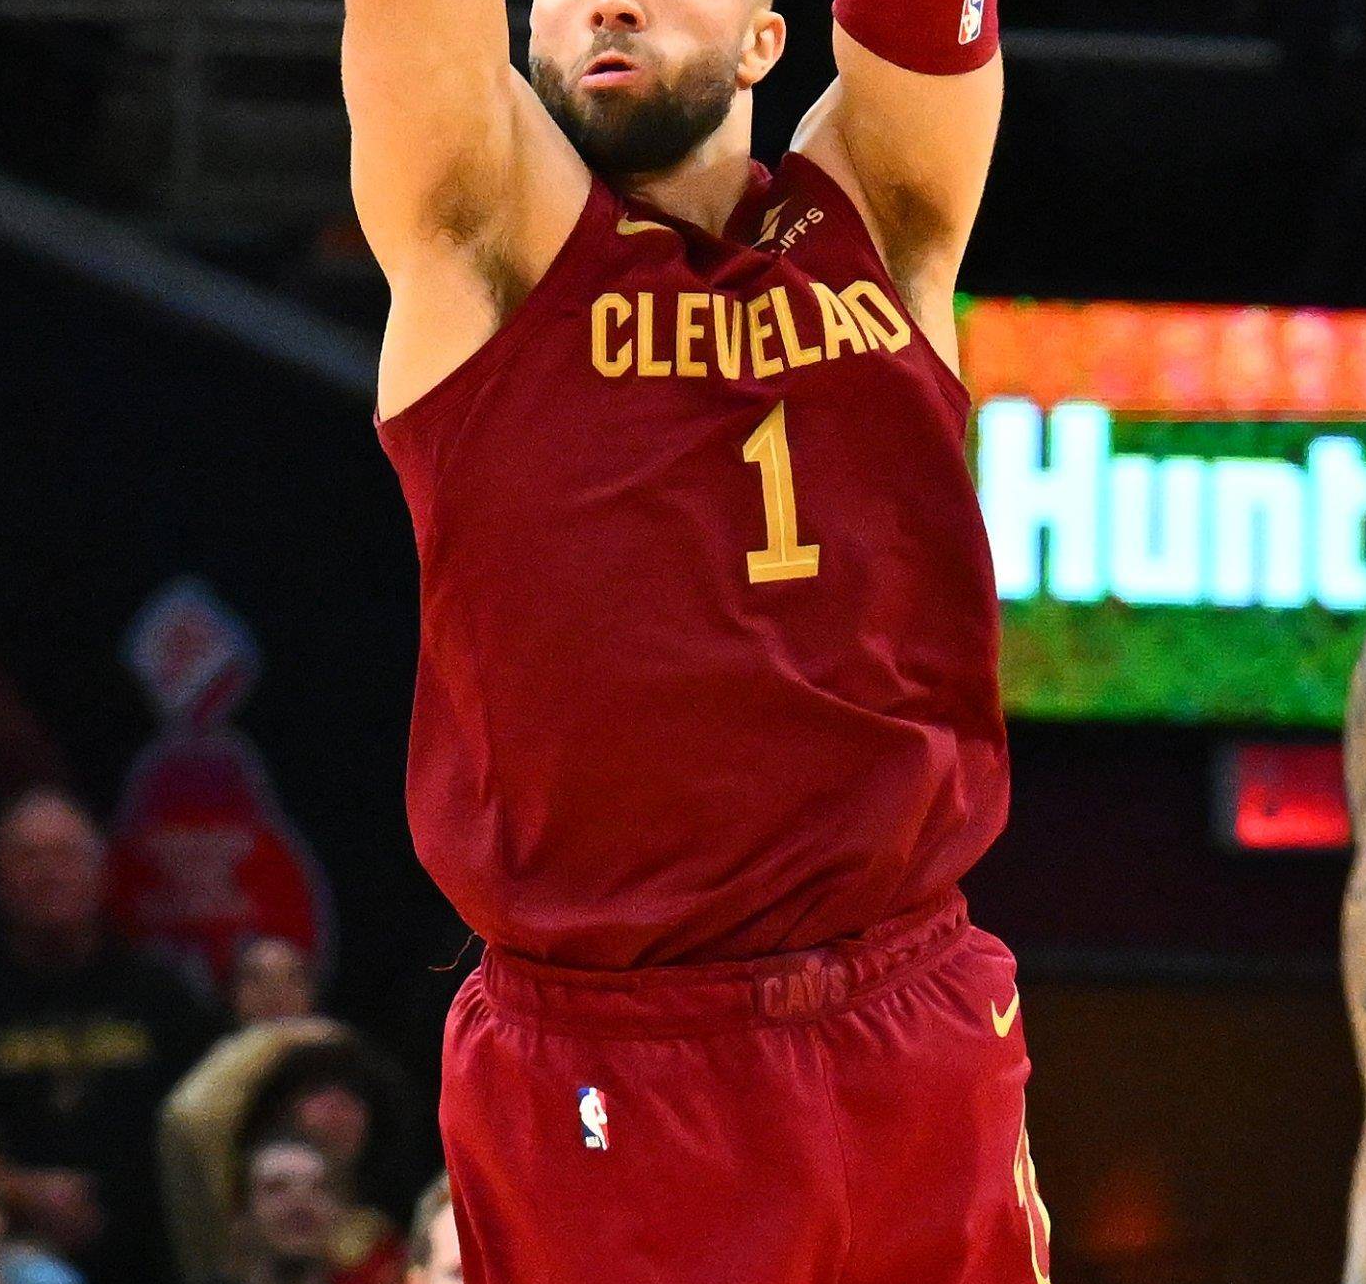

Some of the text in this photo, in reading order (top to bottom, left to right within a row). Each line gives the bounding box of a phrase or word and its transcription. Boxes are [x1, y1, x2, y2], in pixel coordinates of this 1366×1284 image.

[591, 279, 912, 381] CLEVELAD
[741, 399, 820, 585] 1
[763, 961, 847, 1018] CAVS
